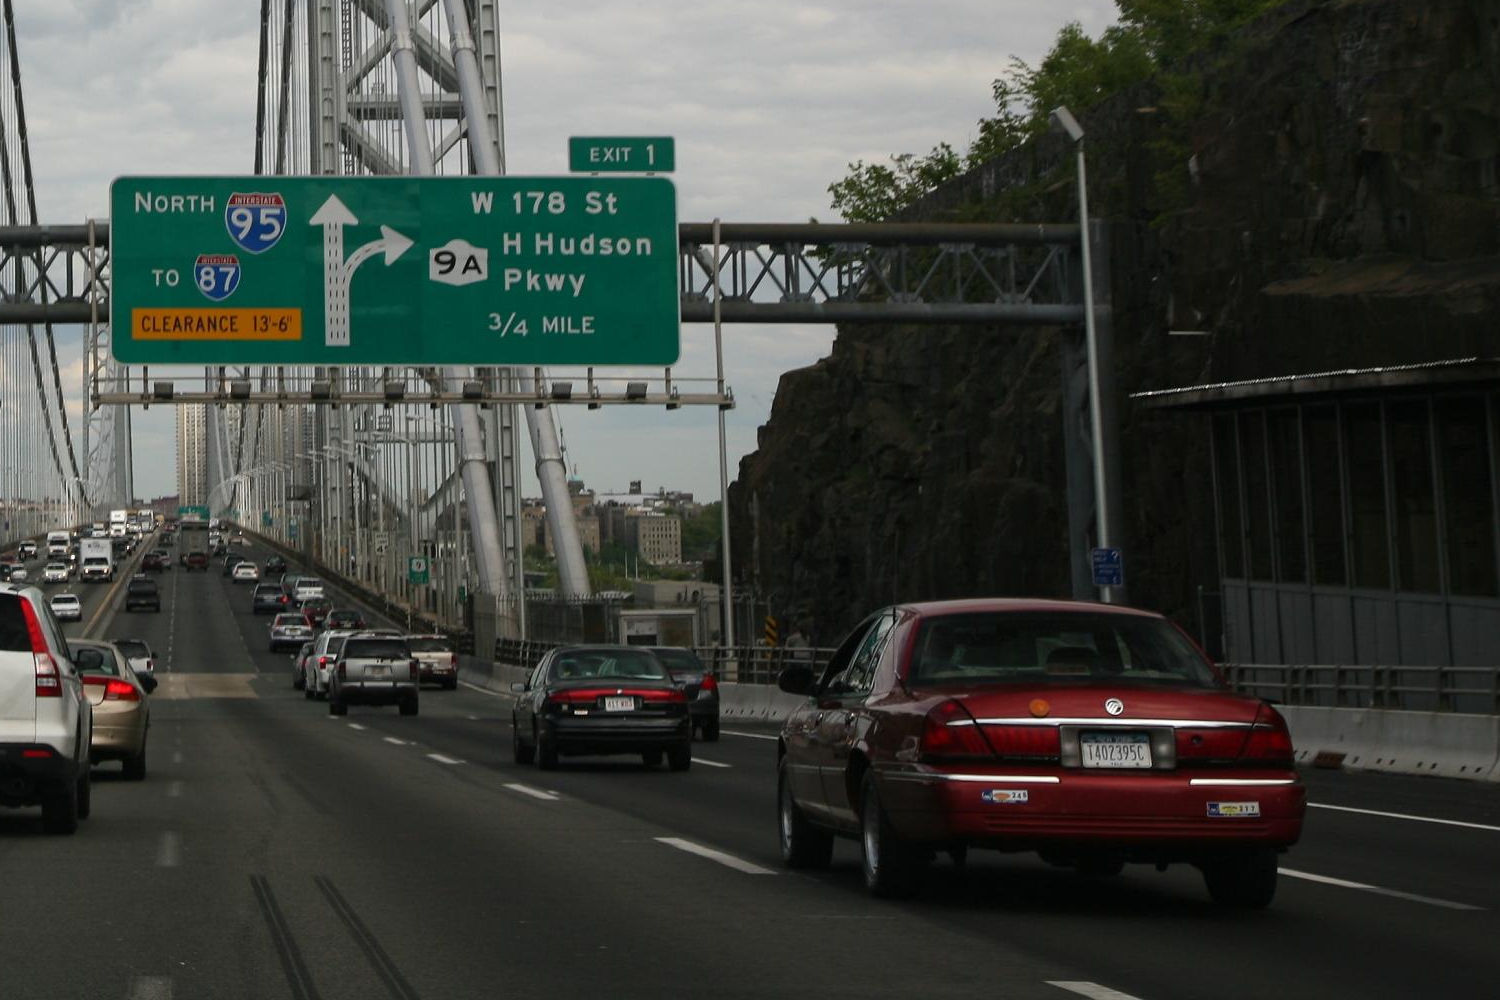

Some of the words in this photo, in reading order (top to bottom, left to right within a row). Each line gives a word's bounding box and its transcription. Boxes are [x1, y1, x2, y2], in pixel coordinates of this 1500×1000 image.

[589, 147, 632, 162] EXIT
[646, 144, 654, 165] 1
[134, 191, 215, 213] NORTH
[234, 195, 276, 205] INTERSTATE
[471, 191, 493, 214] W
[513, 191, 566, 214] 178
[585, 191, 618, 214] St
[230, 208, 281, 242] 95
[503, 232, 522, 255] H
[535, 232, 652, 255] Hudson
[433, 251, 482, 275] 9A
[151, 268, 180, 287] TO
[199, 266, 236, 292] 87
[504, 268, 586, 297] Pkwy
[141, 315, 239, 332] CLEARANCE
[252, 315, 293, 332] 13'-6"
[488, 312, 528, 338] 3/4
[542, 316, 595, 334] MILE
[1087, 744, 1145, 761] T402395C
